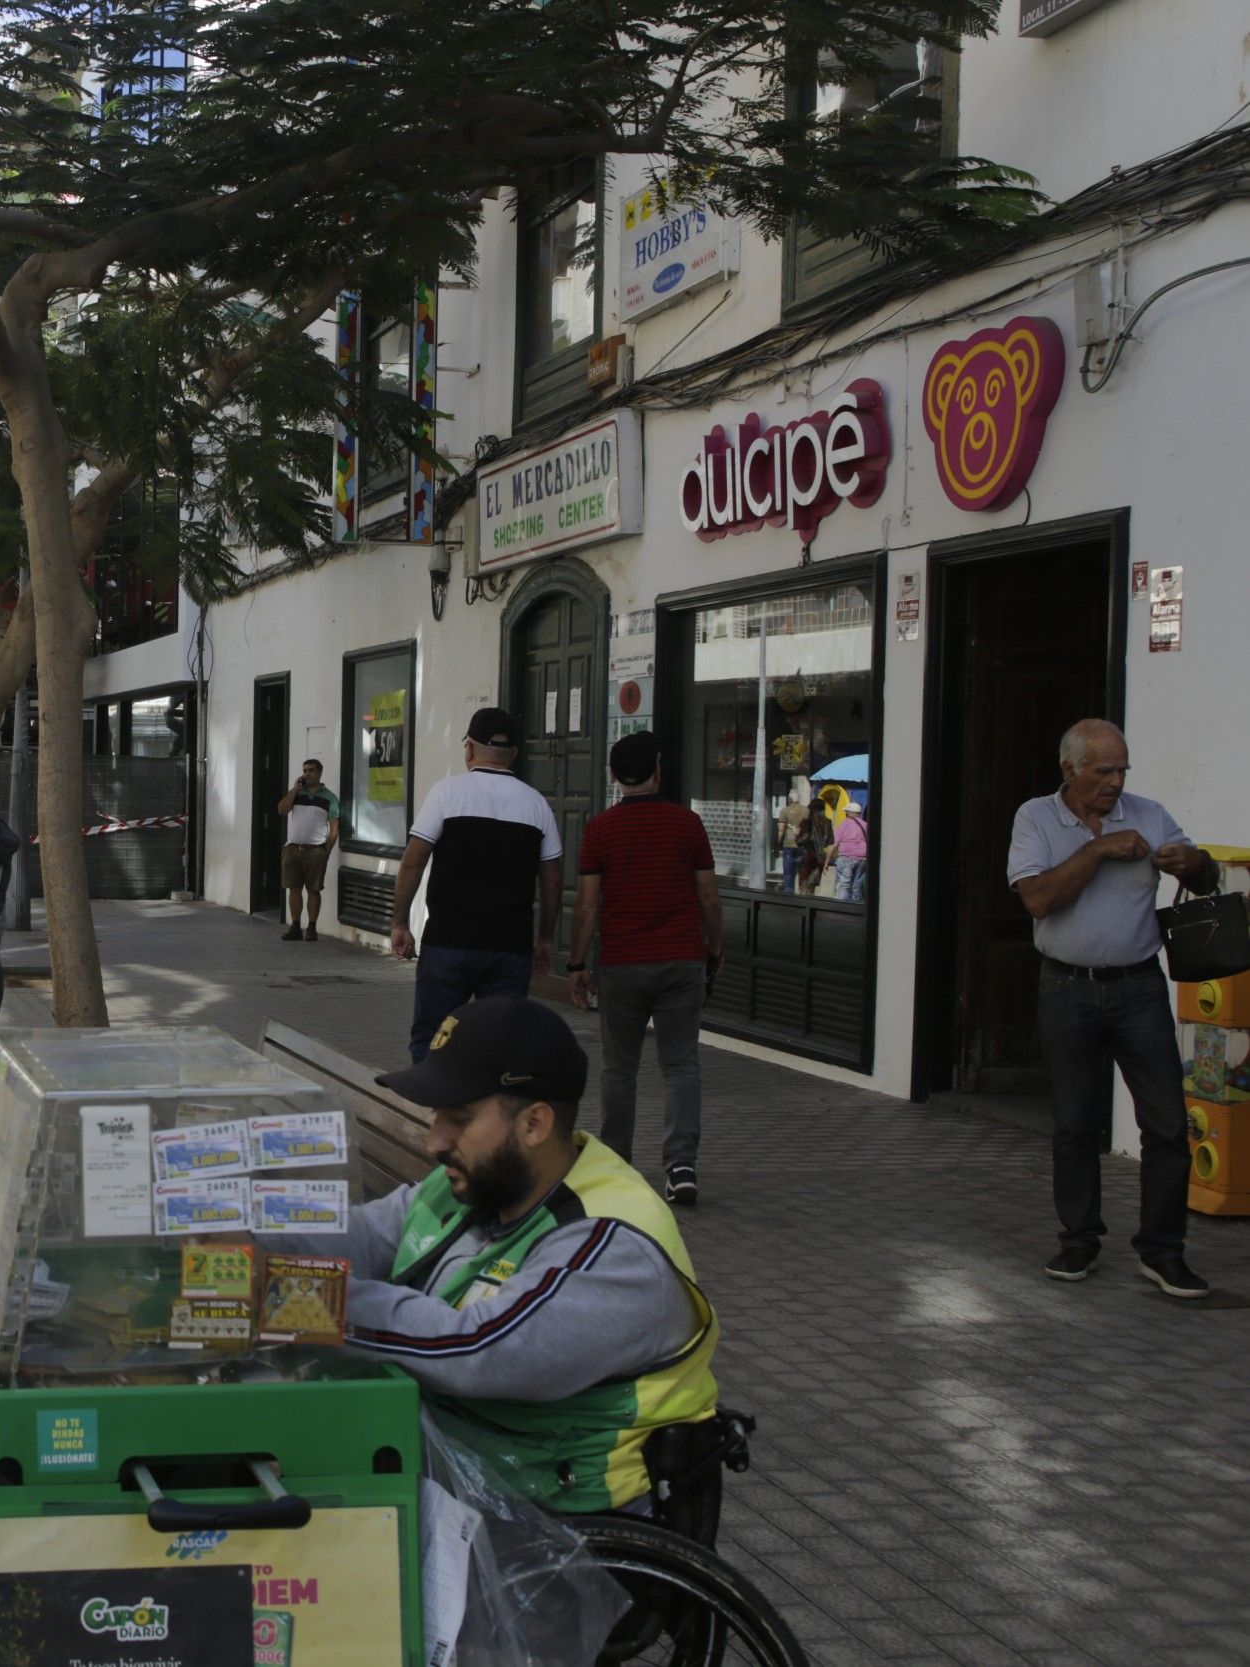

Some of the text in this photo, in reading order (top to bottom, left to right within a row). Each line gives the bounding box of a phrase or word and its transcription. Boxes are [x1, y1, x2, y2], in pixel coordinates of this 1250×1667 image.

[1022, 5, 1045, 28] LOCAL
[486, 440, 611, 518] EL MERCADILLO
[494, 493, 604, 549] SHOPPING CENTER
[1152, 603, 1180, 616] Alarma
[97, 1120, 134, 1135] Triplex
[210, 1308, 247, 1318] BUSCA
[55, 1417, 80, 1428] NO TE
[52, 1428, 85, 1439] RINDAS
[54, 1439, 84, 1450] NUNCA
[173, 1536, 219, 1549] RASCAS
[251, 1578, 319, 1606] IEM
